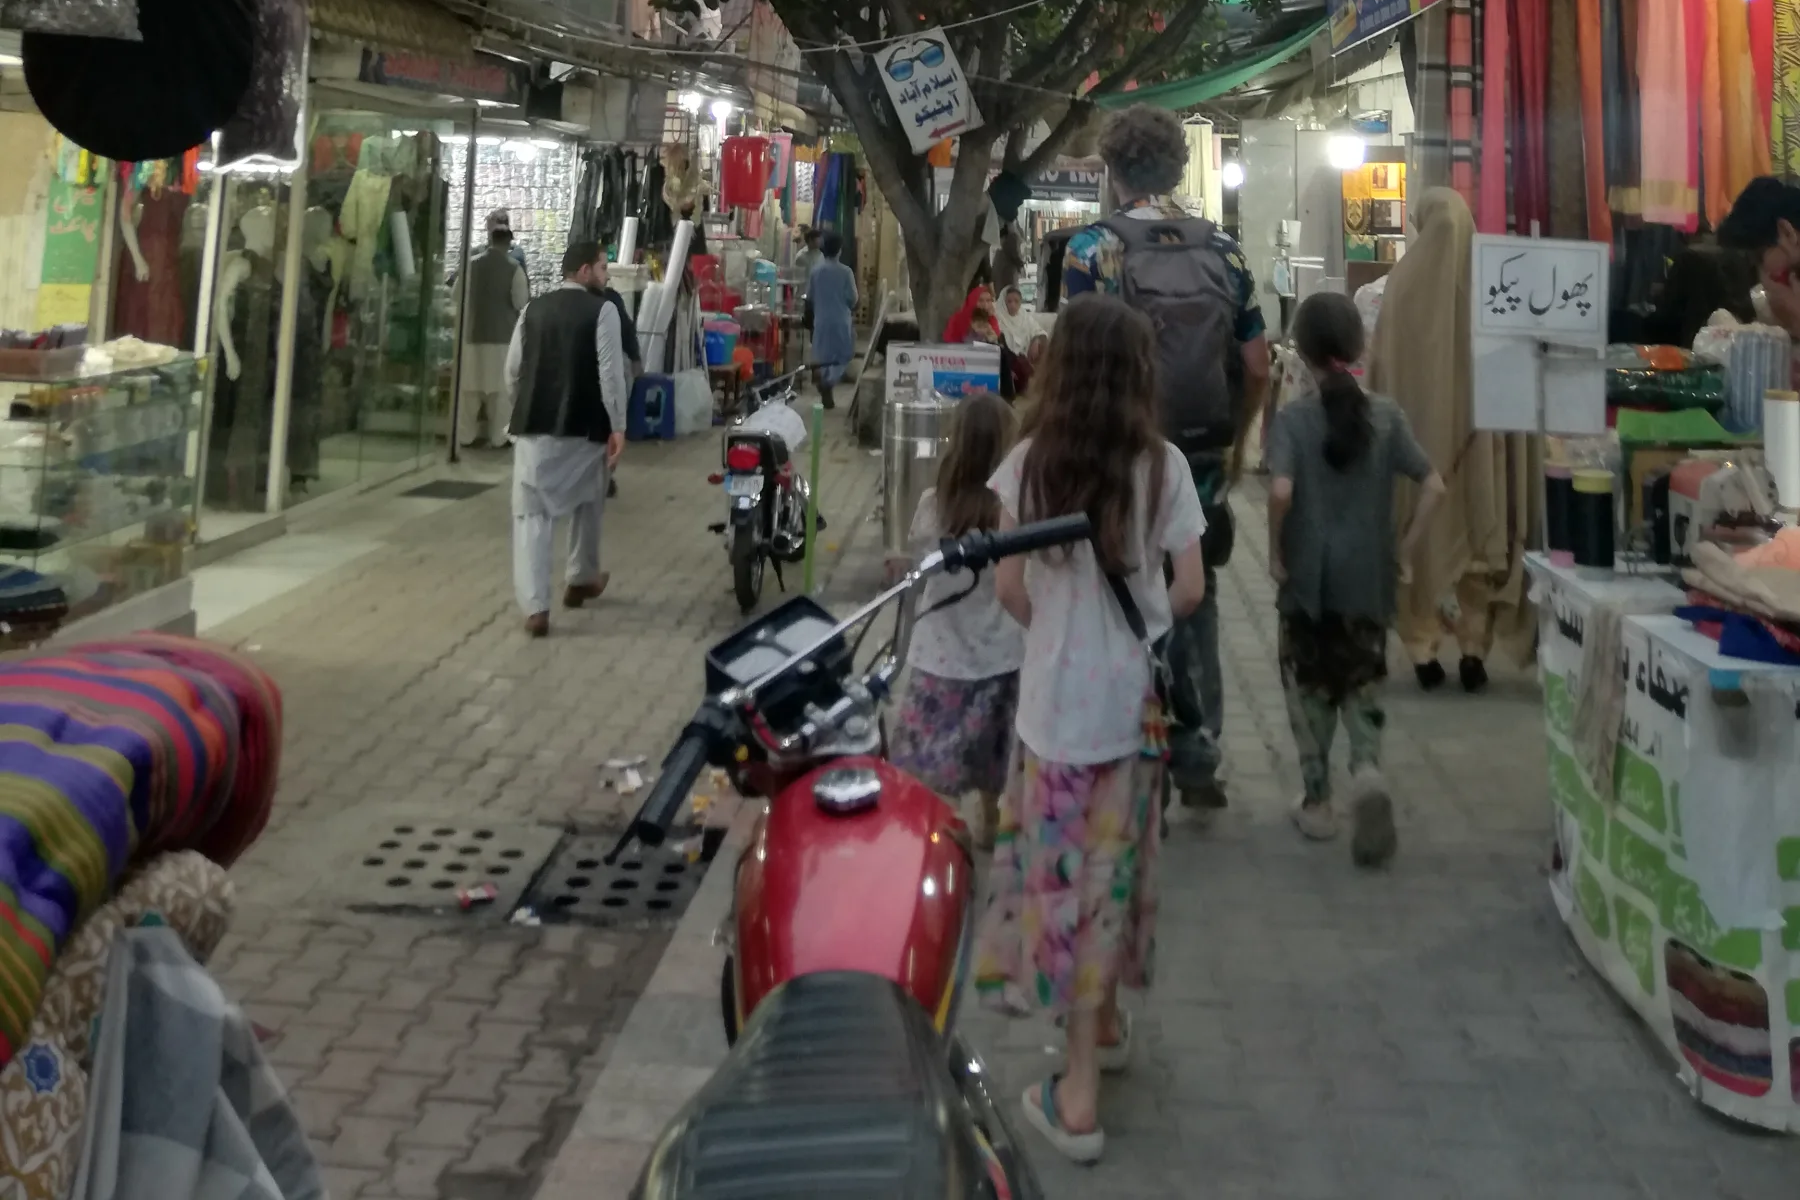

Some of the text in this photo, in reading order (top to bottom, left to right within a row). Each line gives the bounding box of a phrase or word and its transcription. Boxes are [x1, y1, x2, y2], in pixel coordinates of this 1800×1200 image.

[899, 68, 958, 105] اسلام آباد
[1528, 264, 1594, 317] پھول
